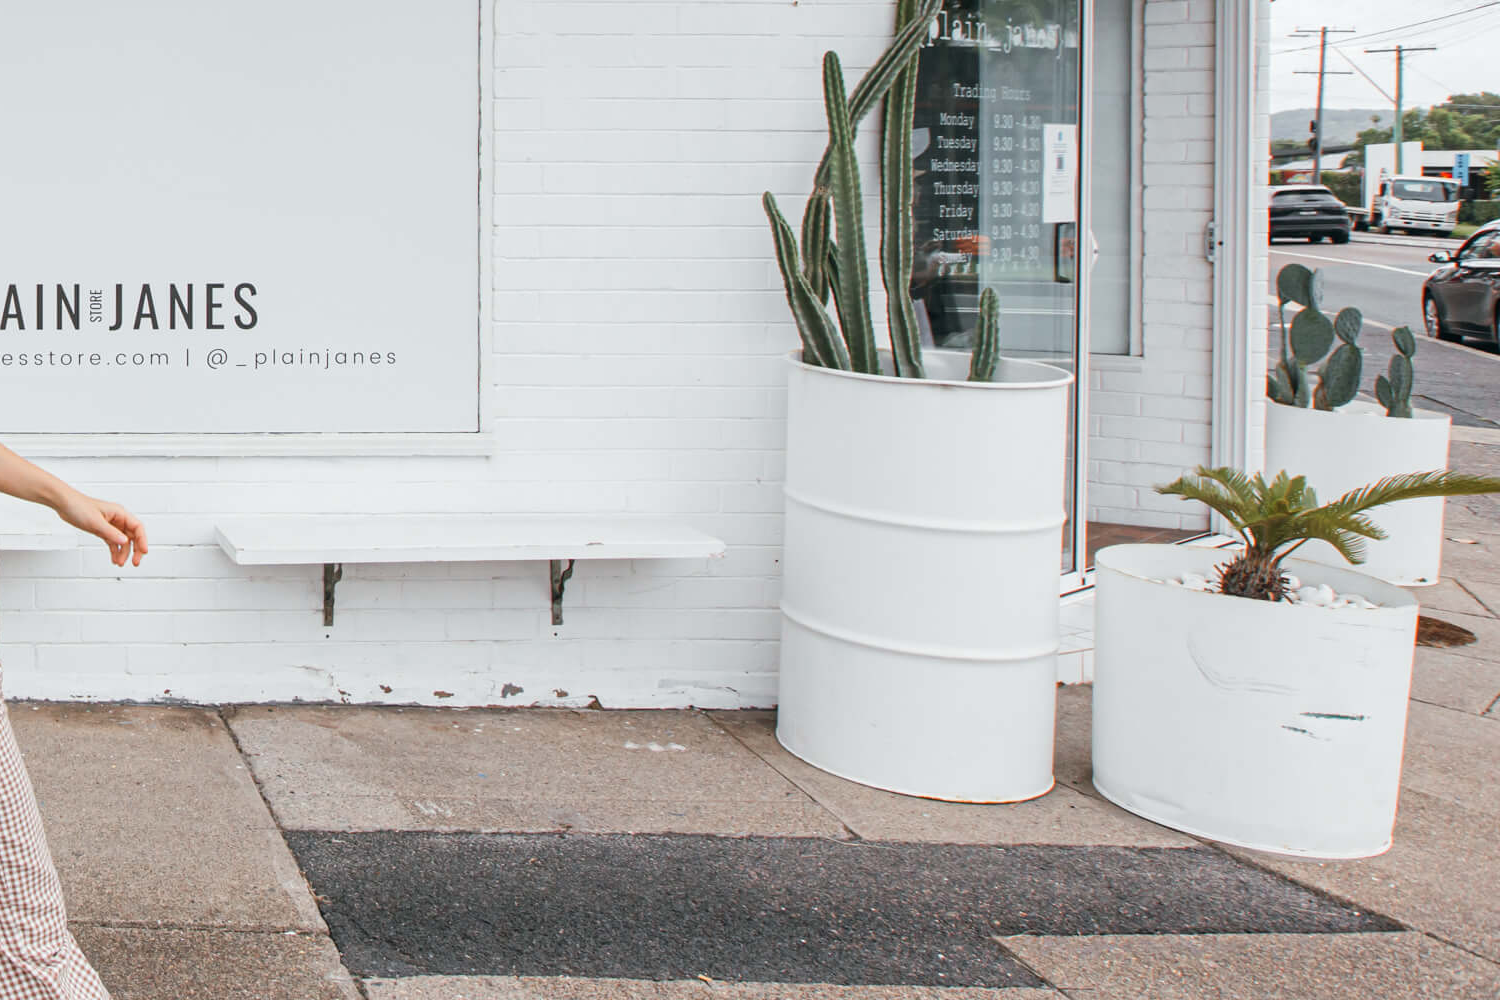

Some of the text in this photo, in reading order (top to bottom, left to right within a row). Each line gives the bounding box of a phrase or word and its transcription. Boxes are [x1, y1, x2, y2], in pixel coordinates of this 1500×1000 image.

[953, 83, 996, 103] Trading
[940, 112, 974, 130] Monday
[937, 136, 977, 152] Tuesday
[931, 158, 980, 175] Wednesday
[933, 181, 980, 198] Thursday
[939, 204, 974, 220] Friday
[933, 227, 980, 243] Saturday
[89, 289, 103, 323] STORE
[109, 283, 258, 331] JANES
[206, 348, 396, 369] @_plainjanes
